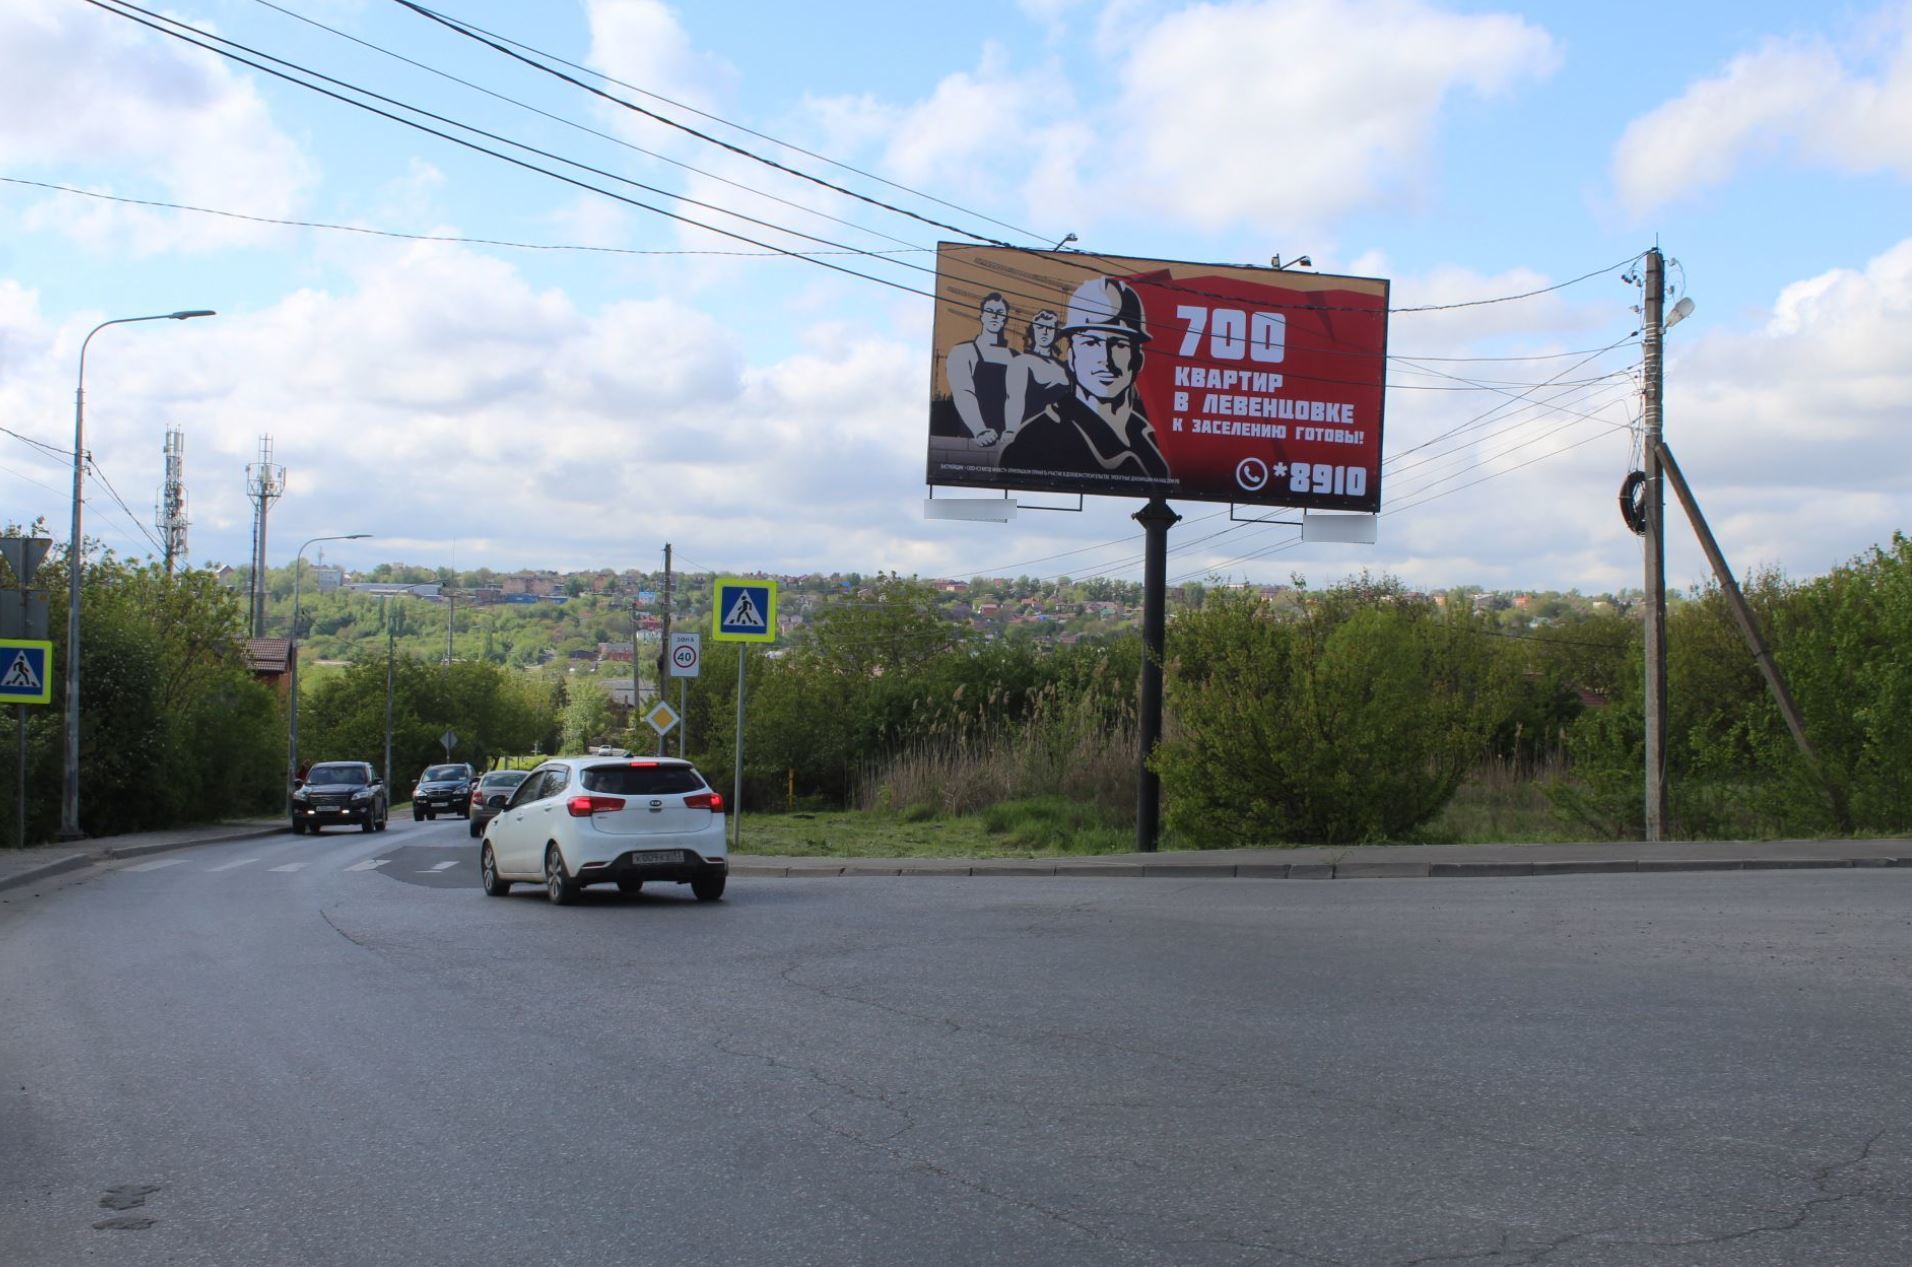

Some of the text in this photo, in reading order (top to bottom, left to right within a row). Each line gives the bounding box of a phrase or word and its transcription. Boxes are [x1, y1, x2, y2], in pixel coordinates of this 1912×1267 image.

[1177, 305, 1286, 363] 700
[1175, 366, 1283, 393] КВАРТИР
[1174, 391, 1354, 423] В ЛЕВЕНЦОВКЕ
[1172, 417, 1365, 445] К ЗАСЕЛЕНИЮ ГОТОВЫ!
[677, 652, 692, 662] 40
